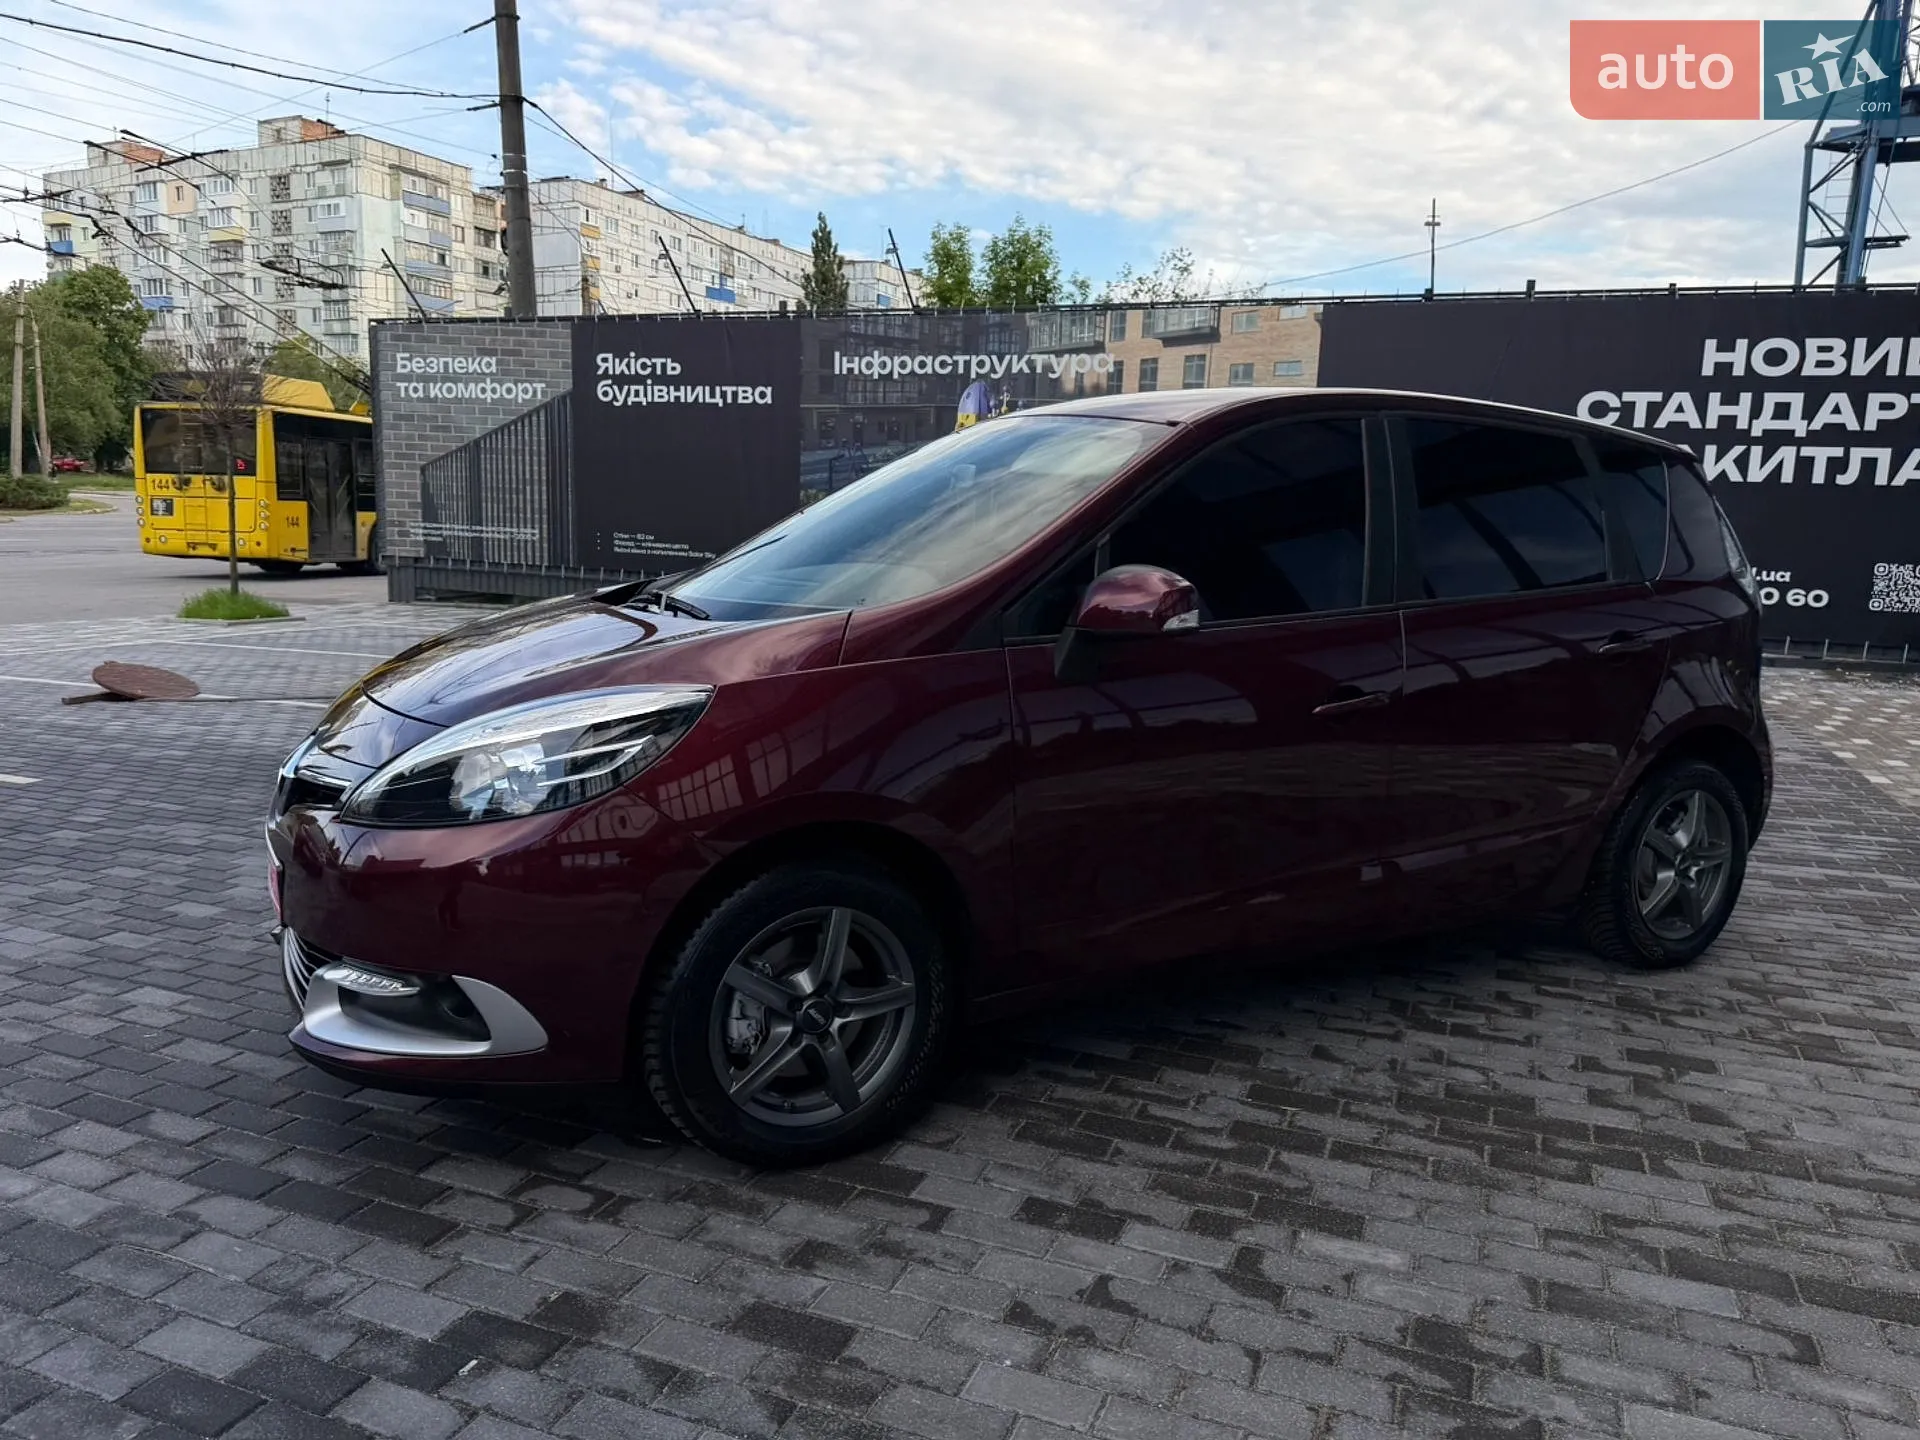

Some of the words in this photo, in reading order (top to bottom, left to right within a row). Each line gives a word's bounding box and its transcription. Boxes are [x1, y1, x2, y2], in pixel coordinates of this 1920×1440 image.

[396, 353, 497, 374] Безпека
[596, 351, 682, 376] Якість
[833, 350, 1116, 379] Інфраструктура
[396, 382, 424, 398] та
[429, 377, 547, 404] комфорт
[596, 379, 773, 408] будівництва
[1576, 390, 1920, 438] СТАНДАР
[151, 478, 170, 491] 144
[286, 514, 300, 528] 144
[1785, 587, 1830, 608] 60
